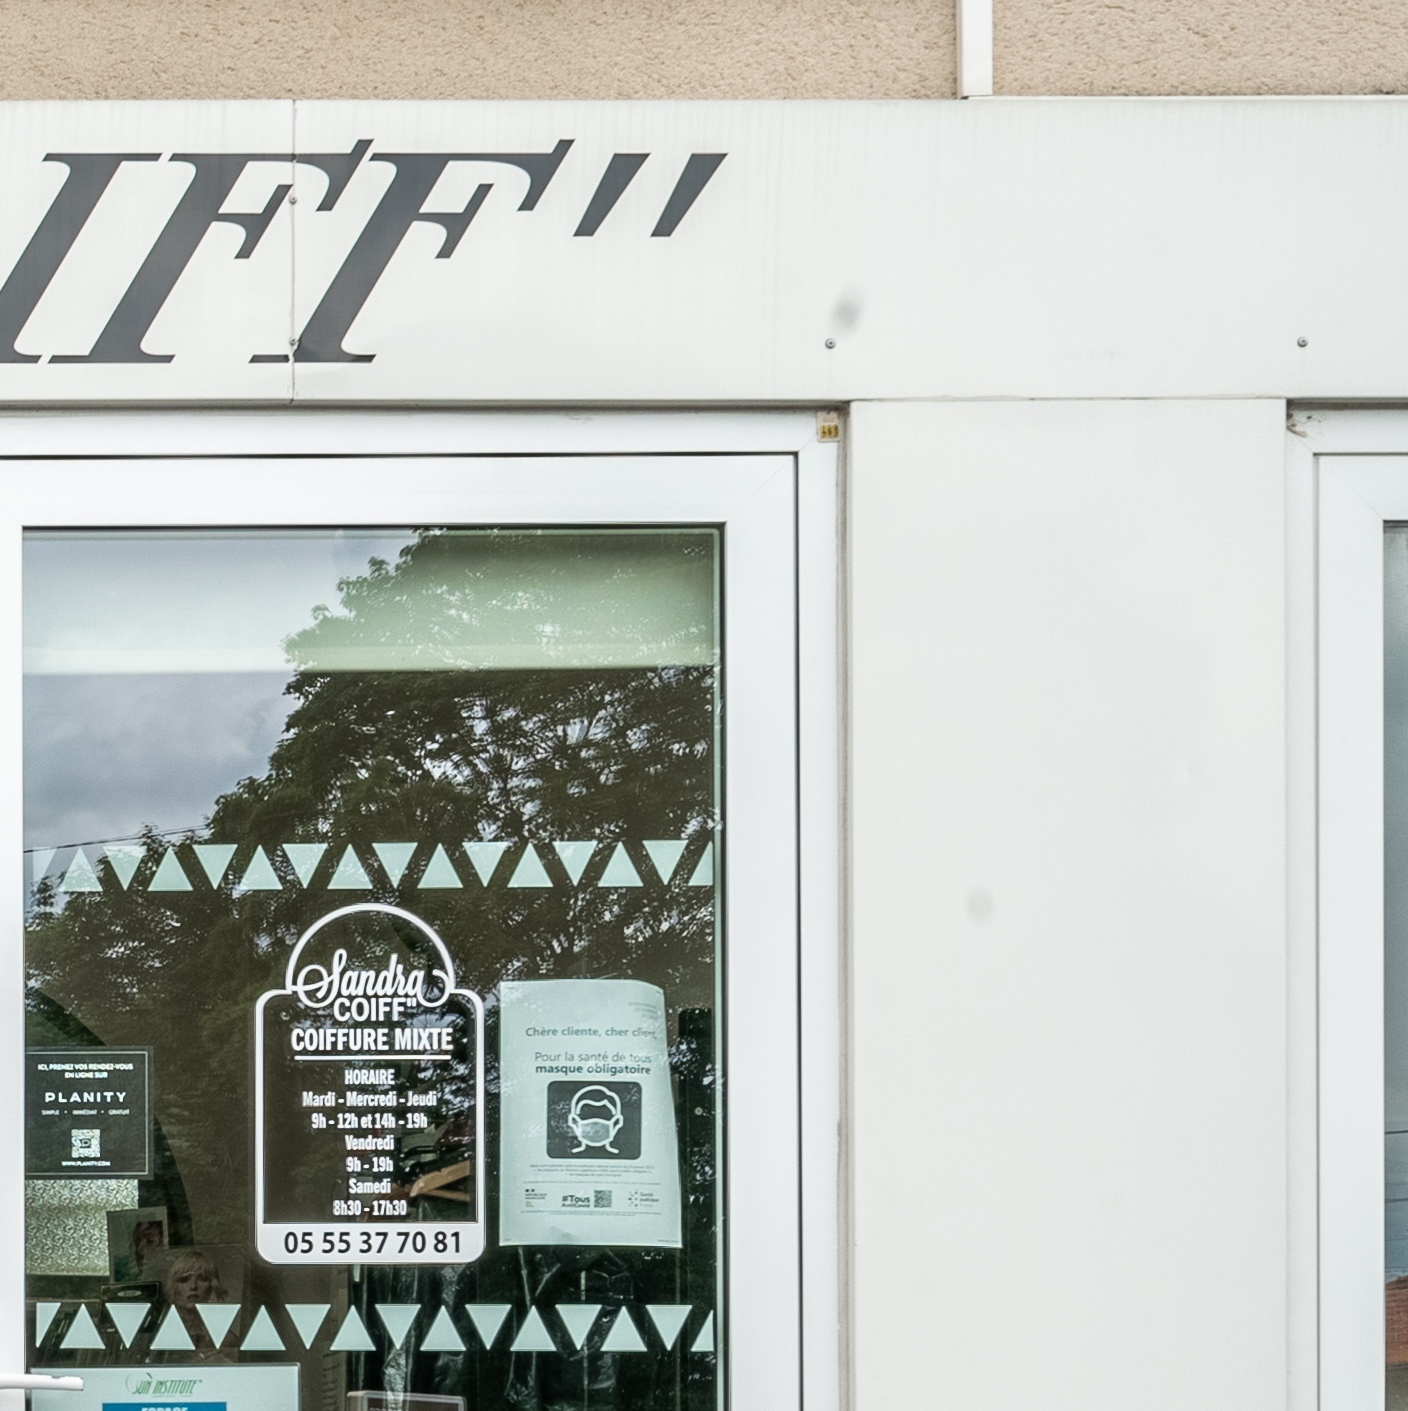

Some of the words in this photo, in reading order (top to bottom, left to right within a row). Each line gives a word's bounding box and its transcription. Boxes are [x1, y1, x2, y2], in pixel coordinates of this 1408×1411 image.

[289, 948, 451, 1008] Sandra
[291, 1028, 389, 1051] COIFFURE
[394, 1027, 454, 1050] MIXTE
[525, 1026, 558, 1037] Chère
[561, 1027, 602, 1037] cliente,
[604, 1027, 629, 1037] cher
[534, 1052, 561, 1062] Pour
[564, 1051, 575, 1062] la
[578, 1051, 609, 1062] santé
[612, 1052, 626, 1062] de
[629, 1053, 652, 1063] tous
[344, 1069, 395, 1085] HORAIRE
[535, 1065, 584, 1076] masque
[586, 1064, 652, 1076] obligatoire
[44, 1091, 126, 1103] PLANITY
[301, 1091, 336, 1107] Mardi
[346, 1091, 397, 1107] Mercredi
[406, 1091, 437, 1107] Jeudi
[311, 1113, 327, 1129] 9h
[337, 1113, 359, 1129] 12h
[360, 1114, 373, 1128] et
[374, 1113, 396, 1129] 14h
[406, 1112, 428, 1128] 19h
[344, 1134, 395, 1150] Vendredi
[346, 1156, 361, 1172] 9h
[372, 1156, 394, 1172] 19h
[348, 1178, 391, 1194] Samedi
[561, 1194, 591, 1204] #Tous
[332, 1200, 362, 1216] 8h30
[372, 1200, 407, 1216] 17h30
[284, 1231, 314, 1254] 05
[321, 1231, 351, 1254] 55
[359, 1231, 389, 1253] 37
[396, 1231, 426, 1253] 70
[433, 1231, 461, 1253] 81
